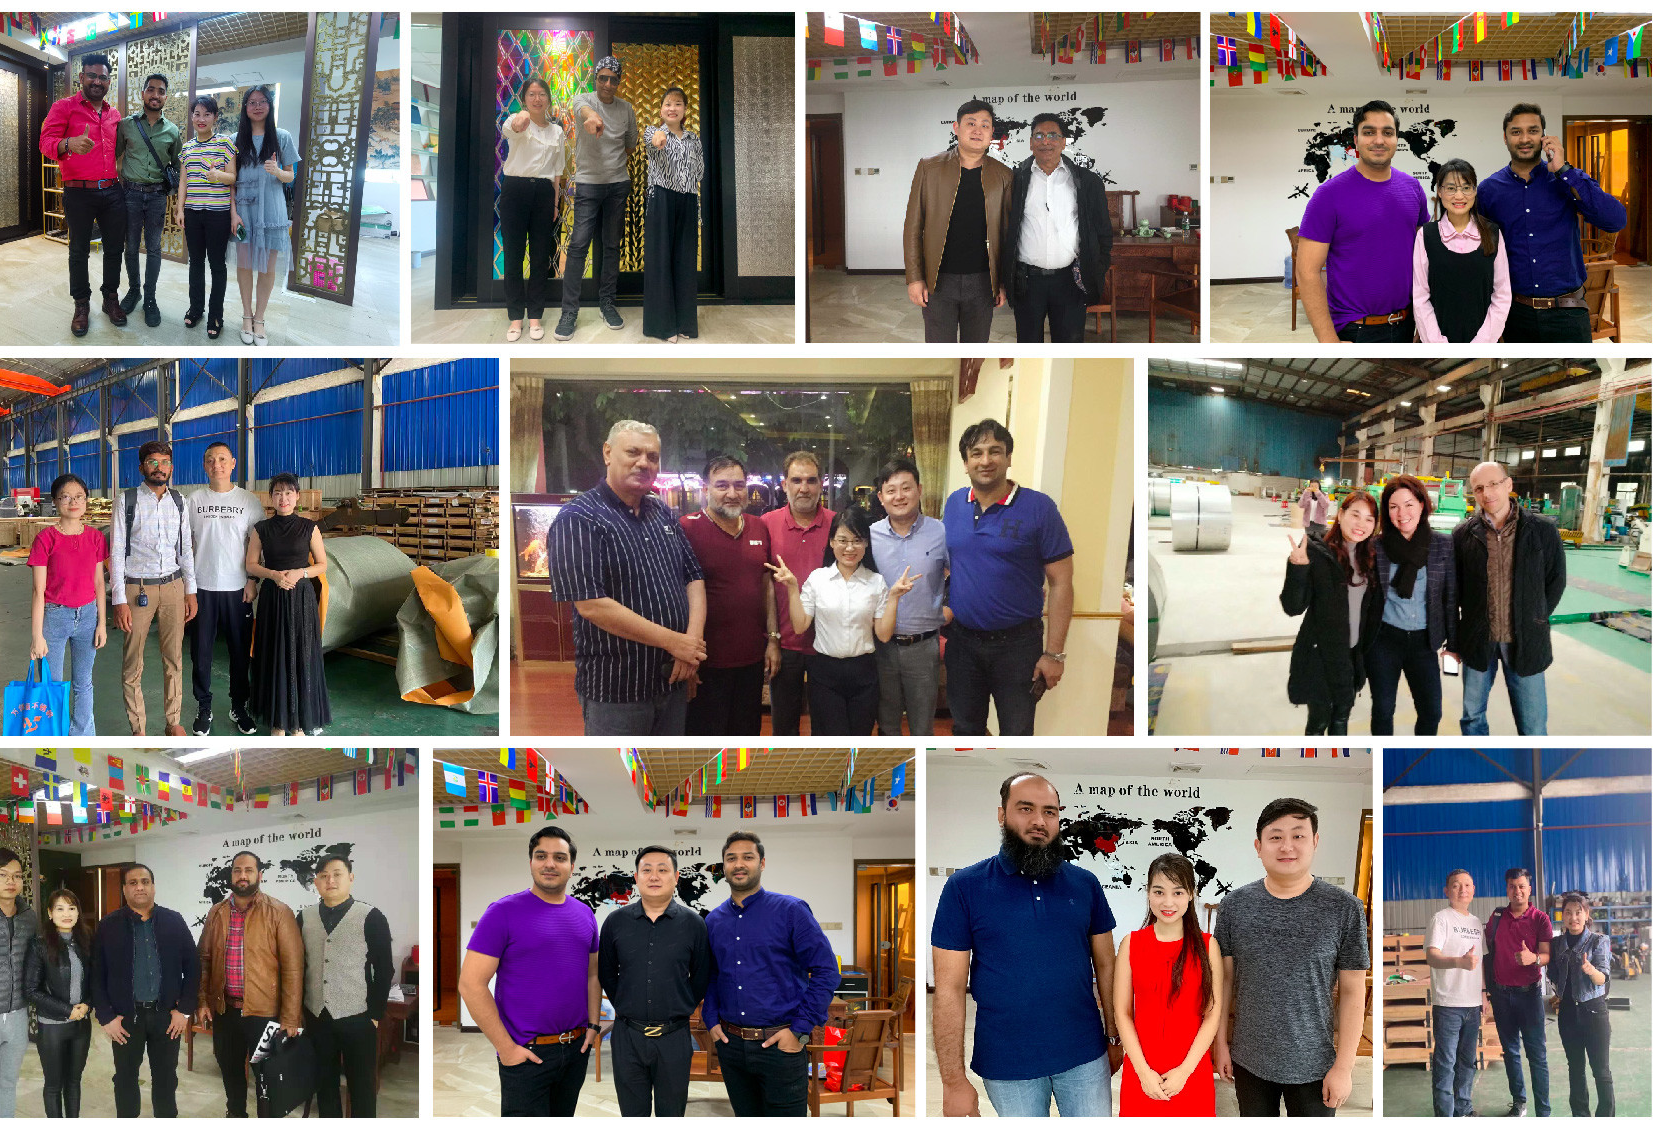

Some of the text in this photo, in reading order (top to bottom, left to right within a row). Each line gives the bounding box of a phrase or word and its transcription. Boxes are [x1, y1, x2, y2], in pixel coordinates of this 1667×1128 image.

[982, 94, 1004, 106] map
[1007, 94, 1020, 103] of
[1023, 93, 1041, 103] the
[1044, 91, 1077, 102] world
[1327, 104, 1336, 114] A
[1400, 104, 1430, 114] world
[197, 505, 245, 515] BURBERRY
[1074, 782, 1201, 799] A map of the world
[222, 828, 322, 848] A map of the world
[592, 847, 601, 857] A
[605, 849, 629, 859] map
[677, 847, 702, 856] orld
